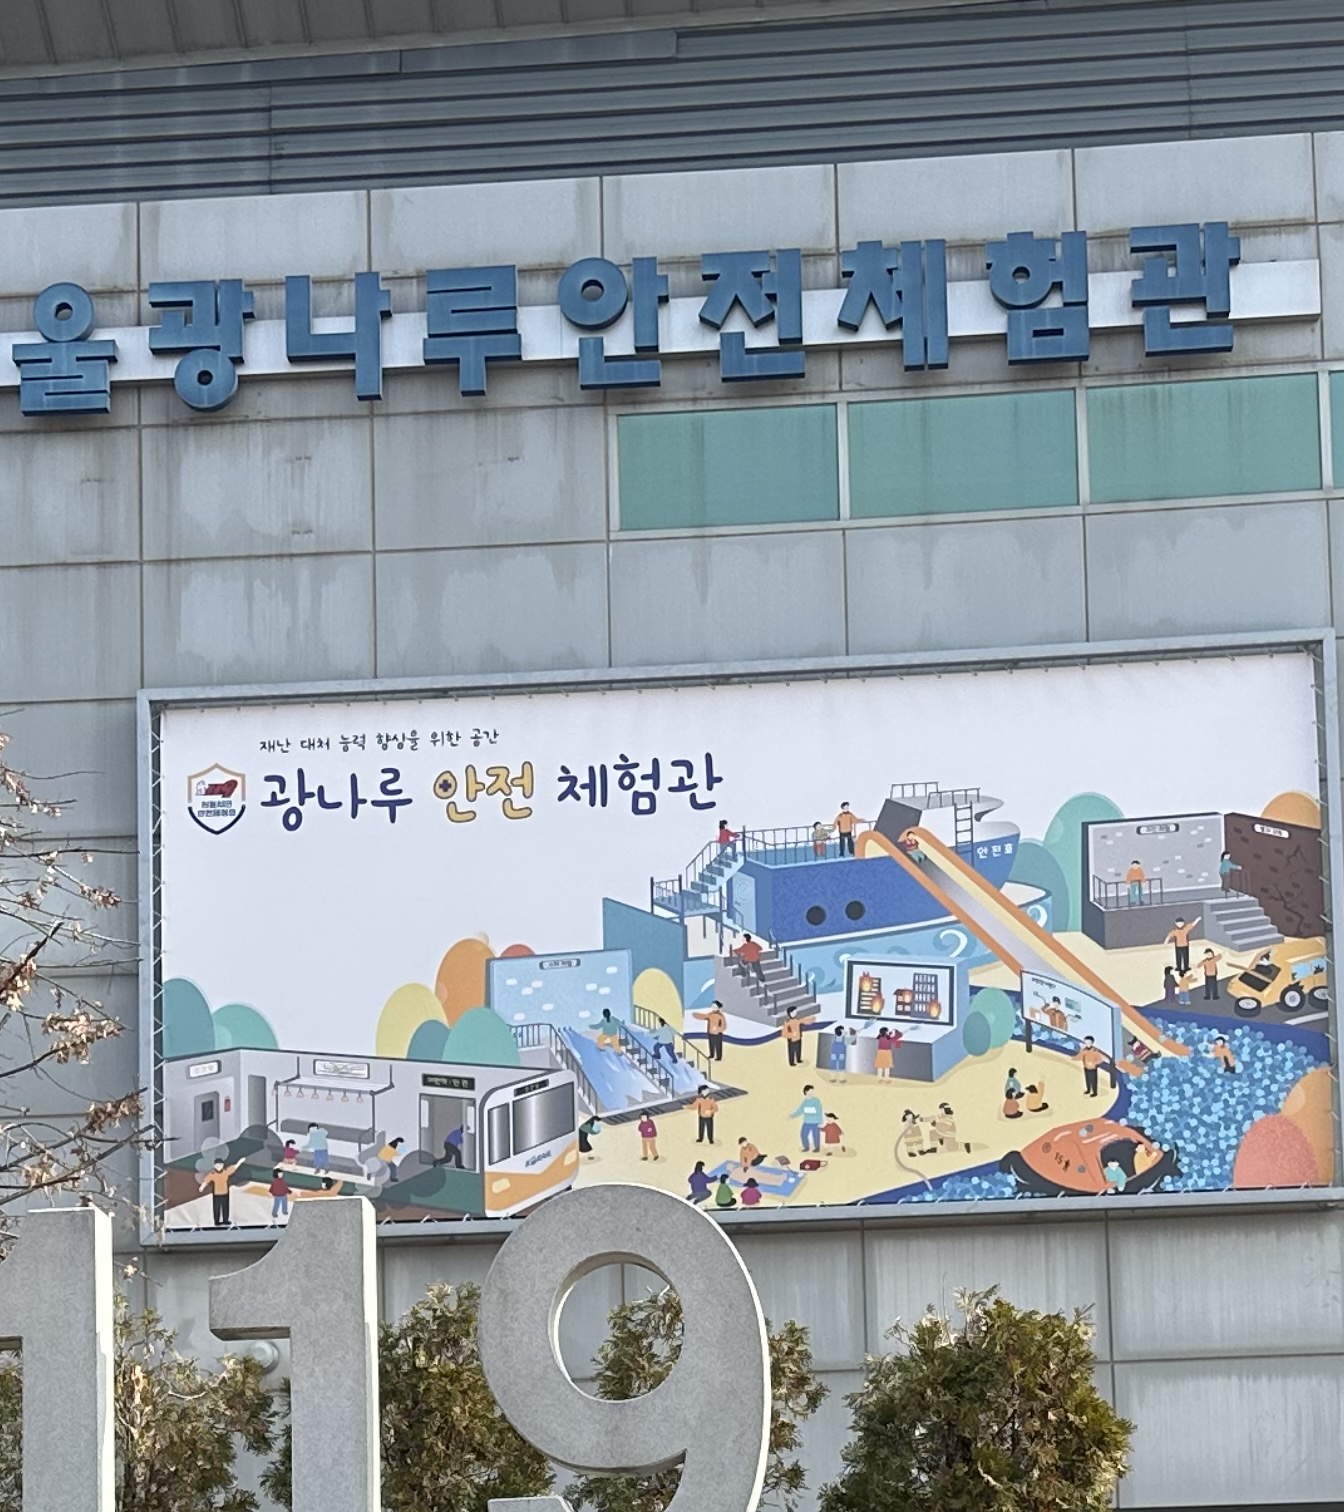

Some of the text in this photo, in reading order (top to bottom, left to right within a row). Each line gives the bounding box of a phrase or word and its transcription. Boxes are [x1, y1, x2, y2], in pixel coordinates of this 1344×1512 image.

[259, 737, 292, 753] 재난
[300, 736, 331, 751] 대처
[338, 733, 367, 752] 능력
[429, 731, 462, 748] 위한
[469, 728, 500, 747] 공간
[260, 752, 724, 832] 광나루 안전 체험관
